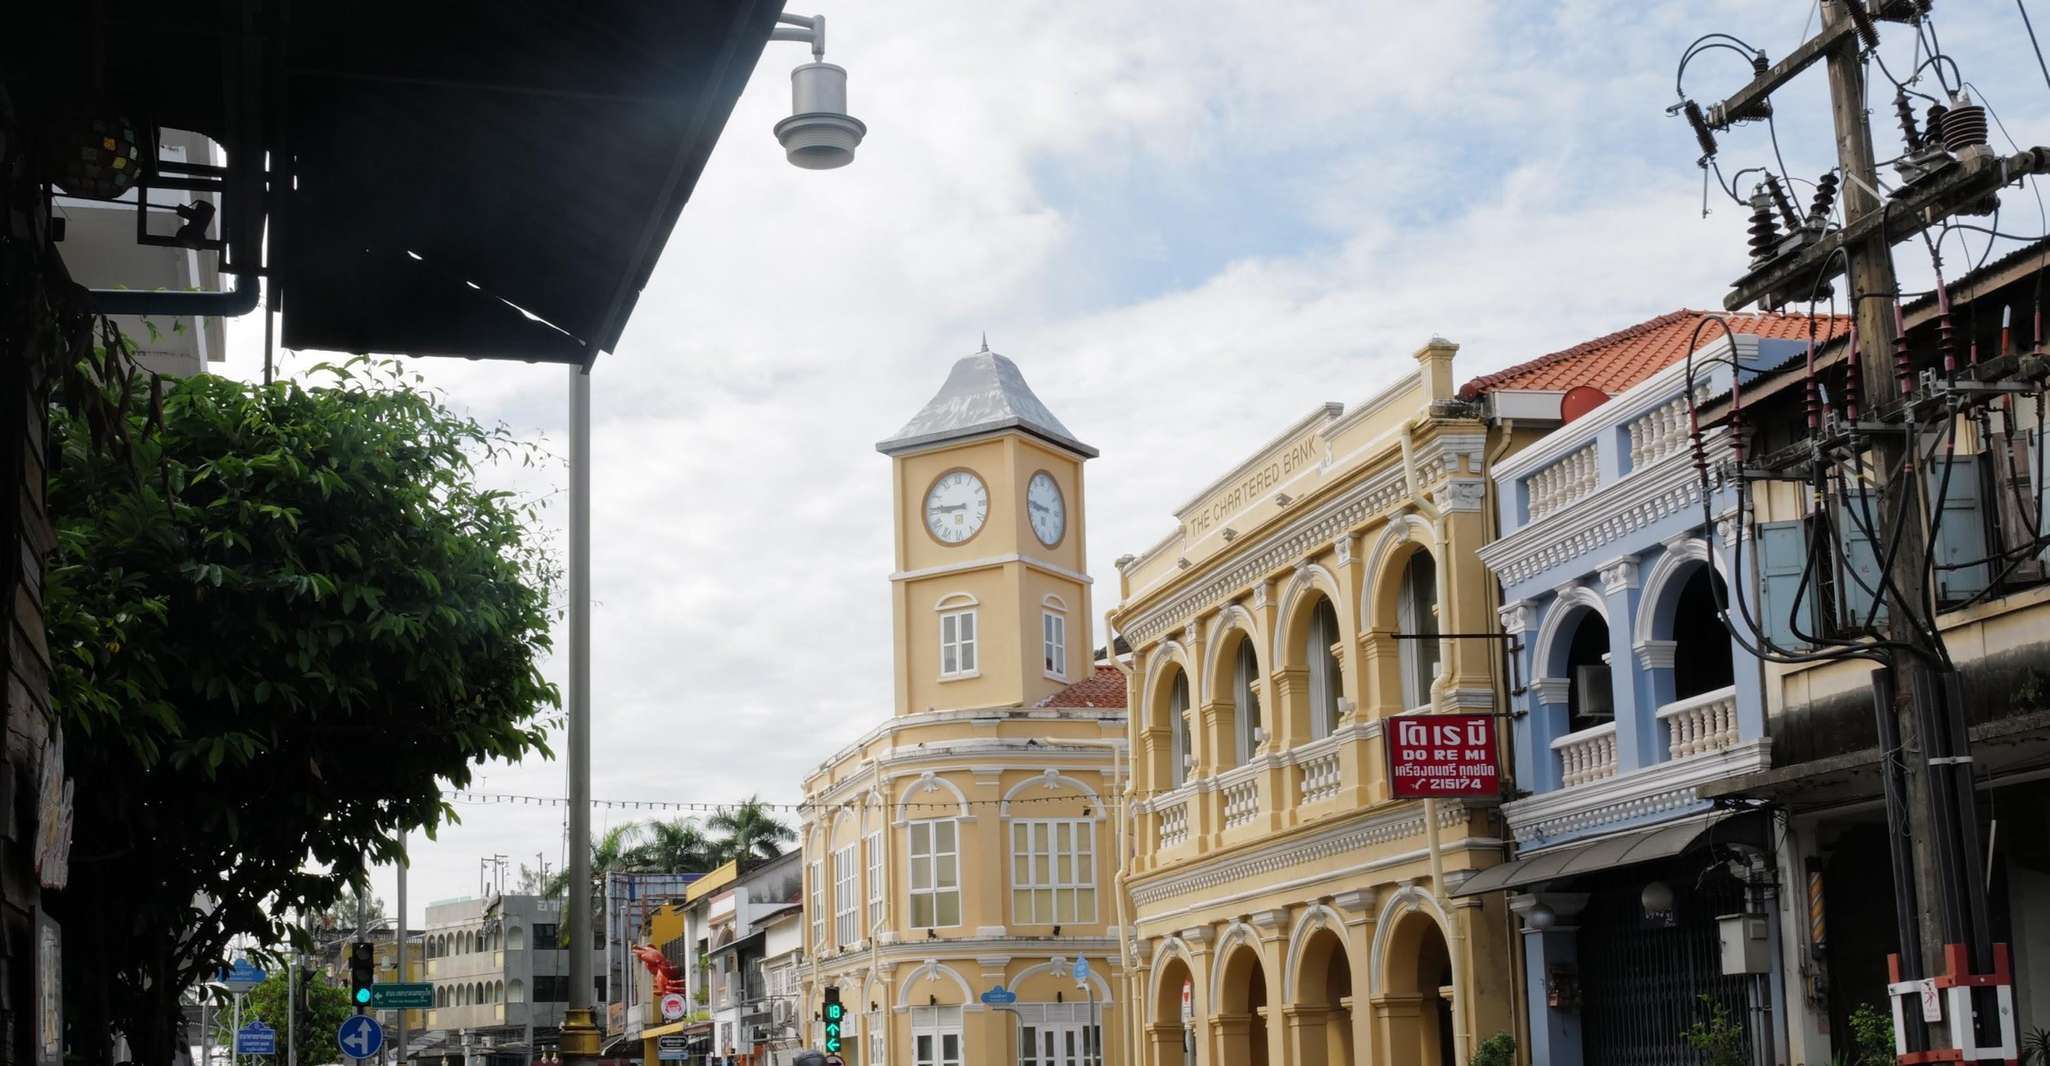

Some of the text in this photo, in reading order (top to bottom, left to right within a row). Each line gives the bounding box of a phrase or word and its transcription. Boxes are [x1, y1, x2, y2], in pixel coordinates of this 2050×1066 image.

[1190, 434, 1317, 536] THE CHARTERED BANK
[1403, 749, 1486, 761] DO RE MI
[1430, 779, 1482, 789] 215174
[829, 1005, 840, 1018] 18
